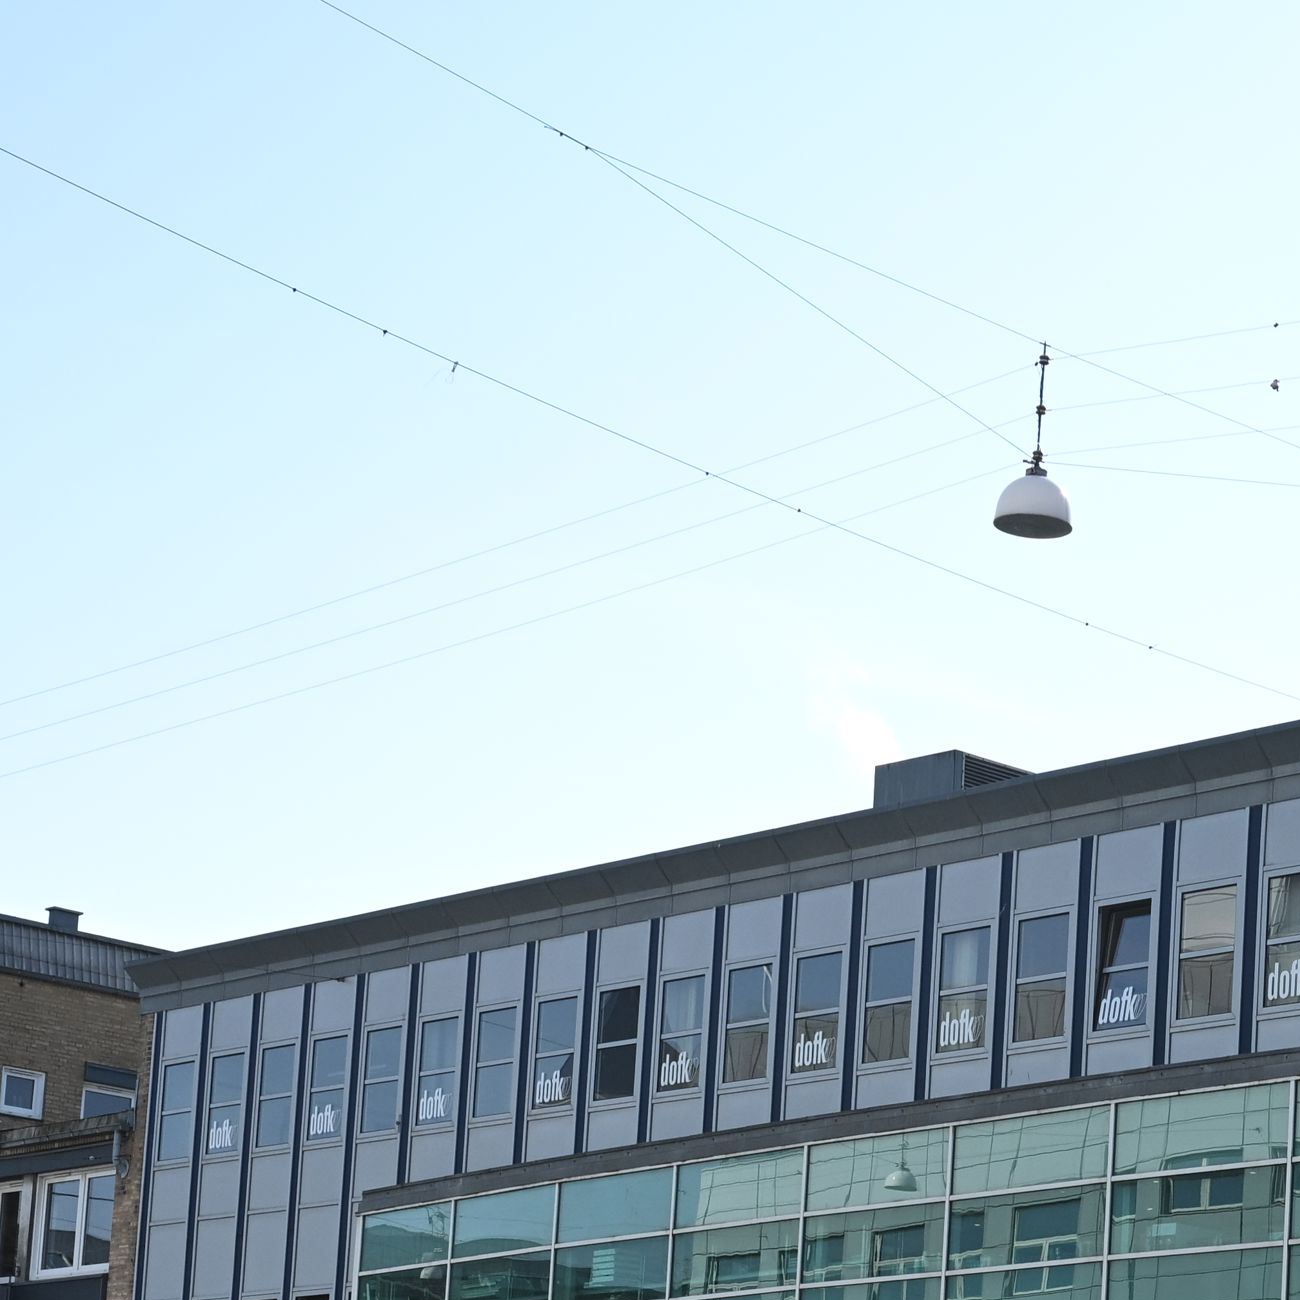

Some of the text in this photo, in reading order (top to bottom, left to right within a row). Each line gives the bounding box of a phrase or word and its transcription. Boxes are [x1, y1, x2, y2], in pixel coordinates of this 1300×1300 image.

[1098, 985, 1138, 1025] dofk
[939, 1007, 976, 1047] dofk
[794, 1030, 828, 1067] dofk
[660, 1050, 692, 1088] dofk
[419, 1088, 446, 1121] dofk
[536, 1070, 564, 1104] dofk
[209, 1118, 234, 1150] dofk
[310, 1103, 336, 1136] dofk
